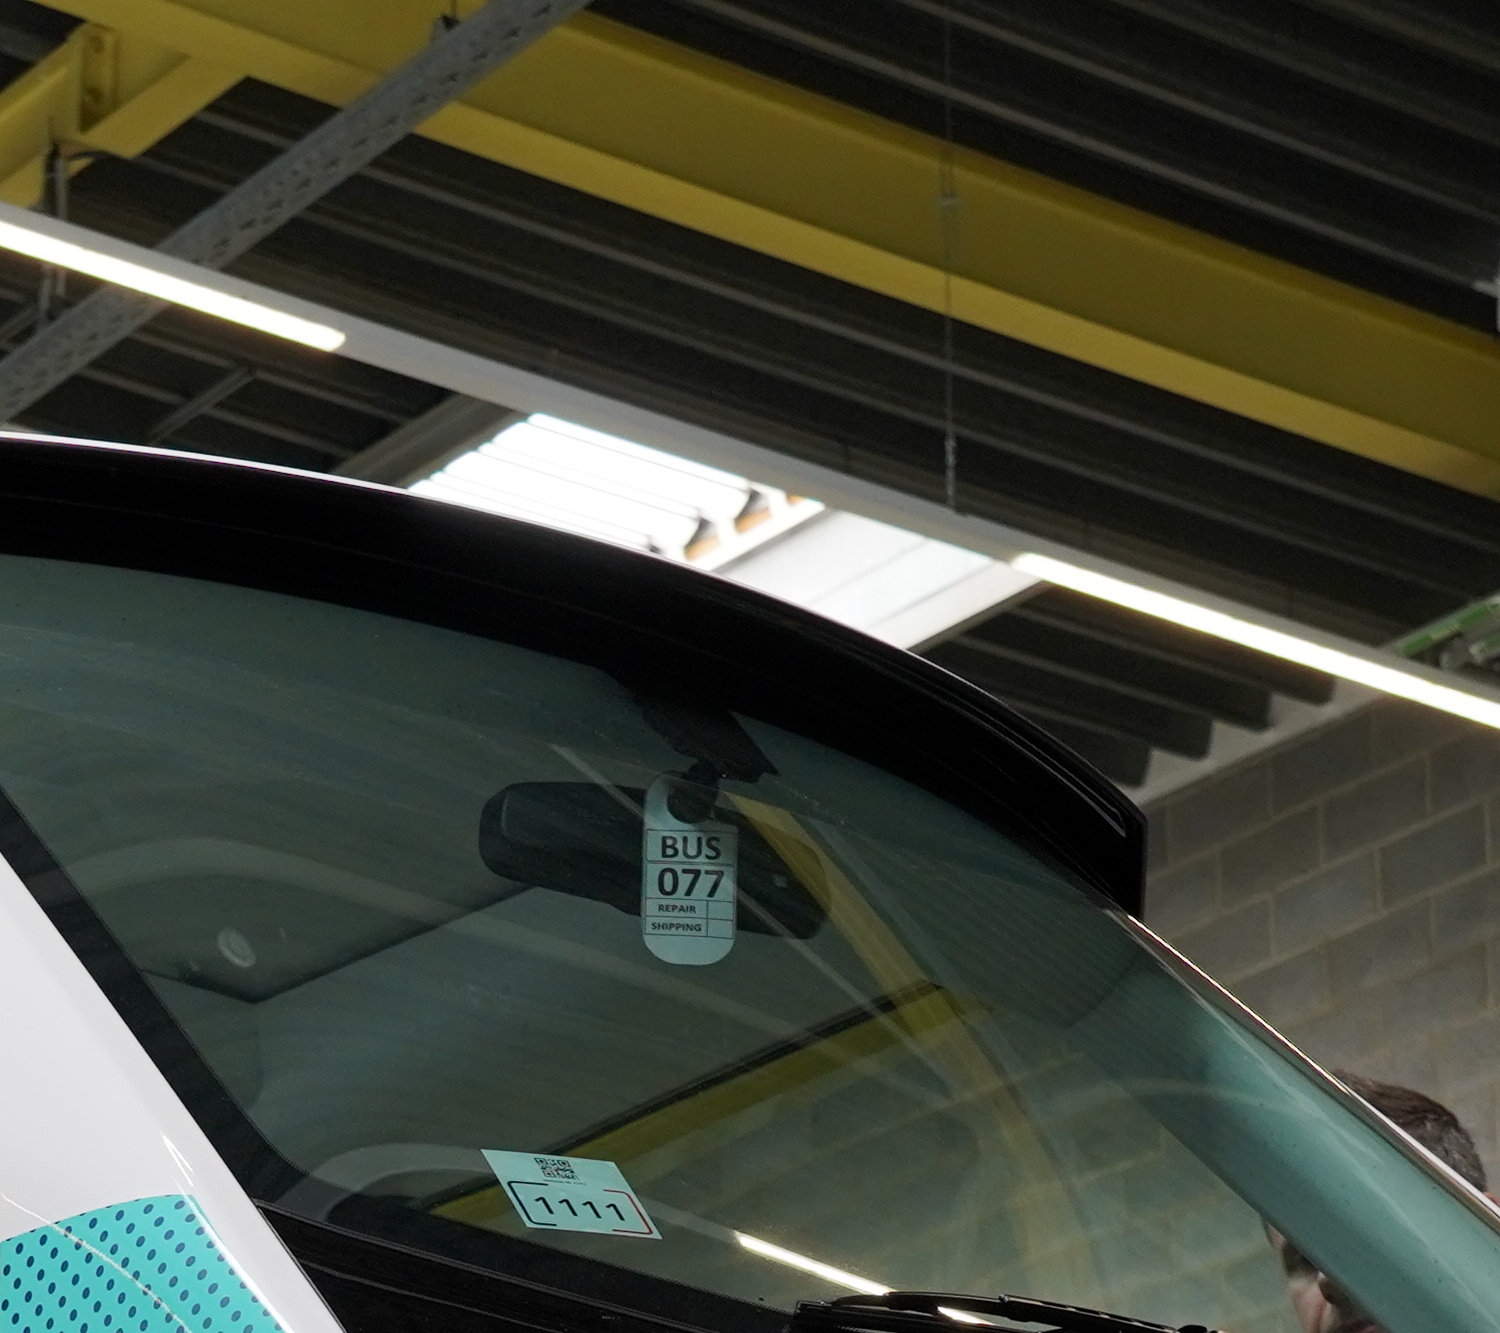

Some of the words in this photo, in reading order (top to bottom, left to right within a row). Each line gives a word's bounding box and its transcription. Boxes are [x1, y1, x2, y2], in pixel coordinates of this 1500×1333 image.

[661, 835, 721, 860] BUS
[657, 867, 725, 898] 077
[658, 903, 697, 914] REPAIR
[650, 921, 703, 932] SHIPPING
[534, 1196, 626, 1221] 1111
